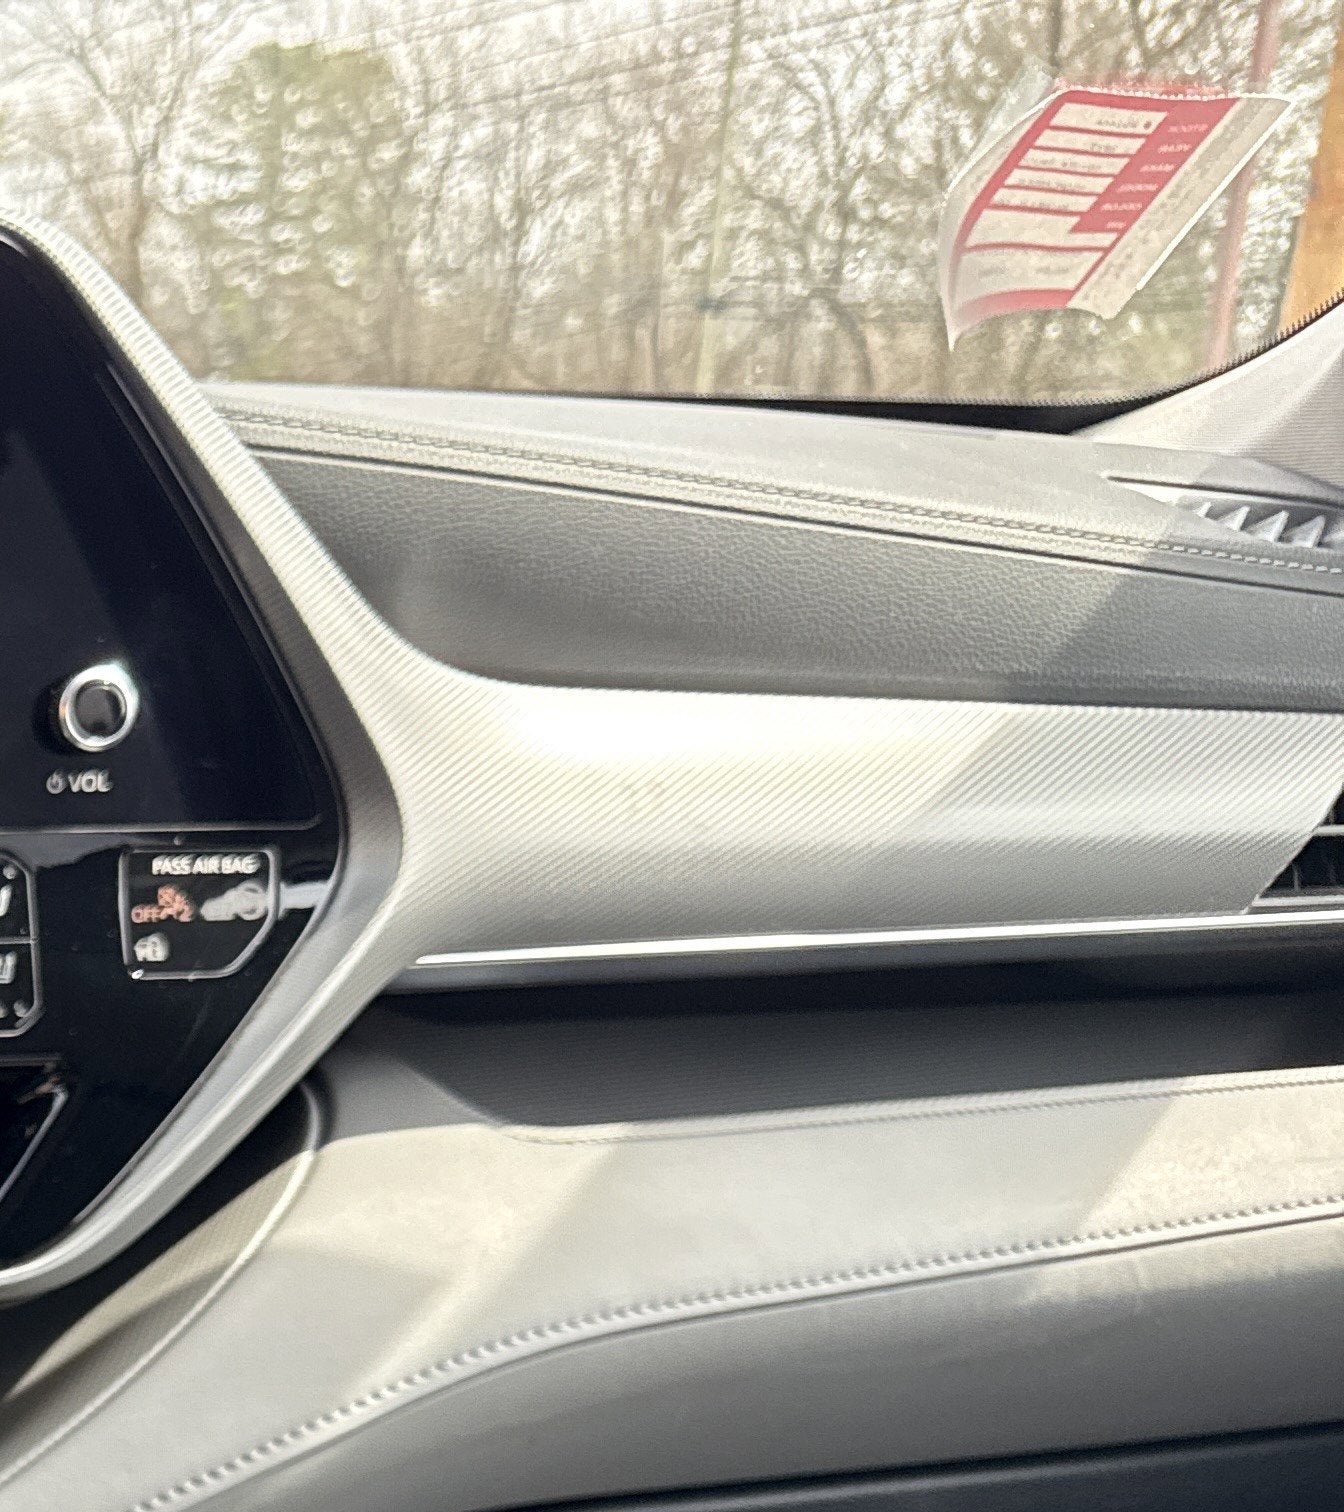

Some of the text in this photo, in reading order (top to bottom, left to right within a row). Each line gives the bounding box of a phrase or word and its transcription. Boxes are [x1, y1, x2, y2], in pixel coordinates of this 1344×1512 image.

[67, 768, 112, 793] VOL
[151, 853, 262, 875] PASS AIR BAG
